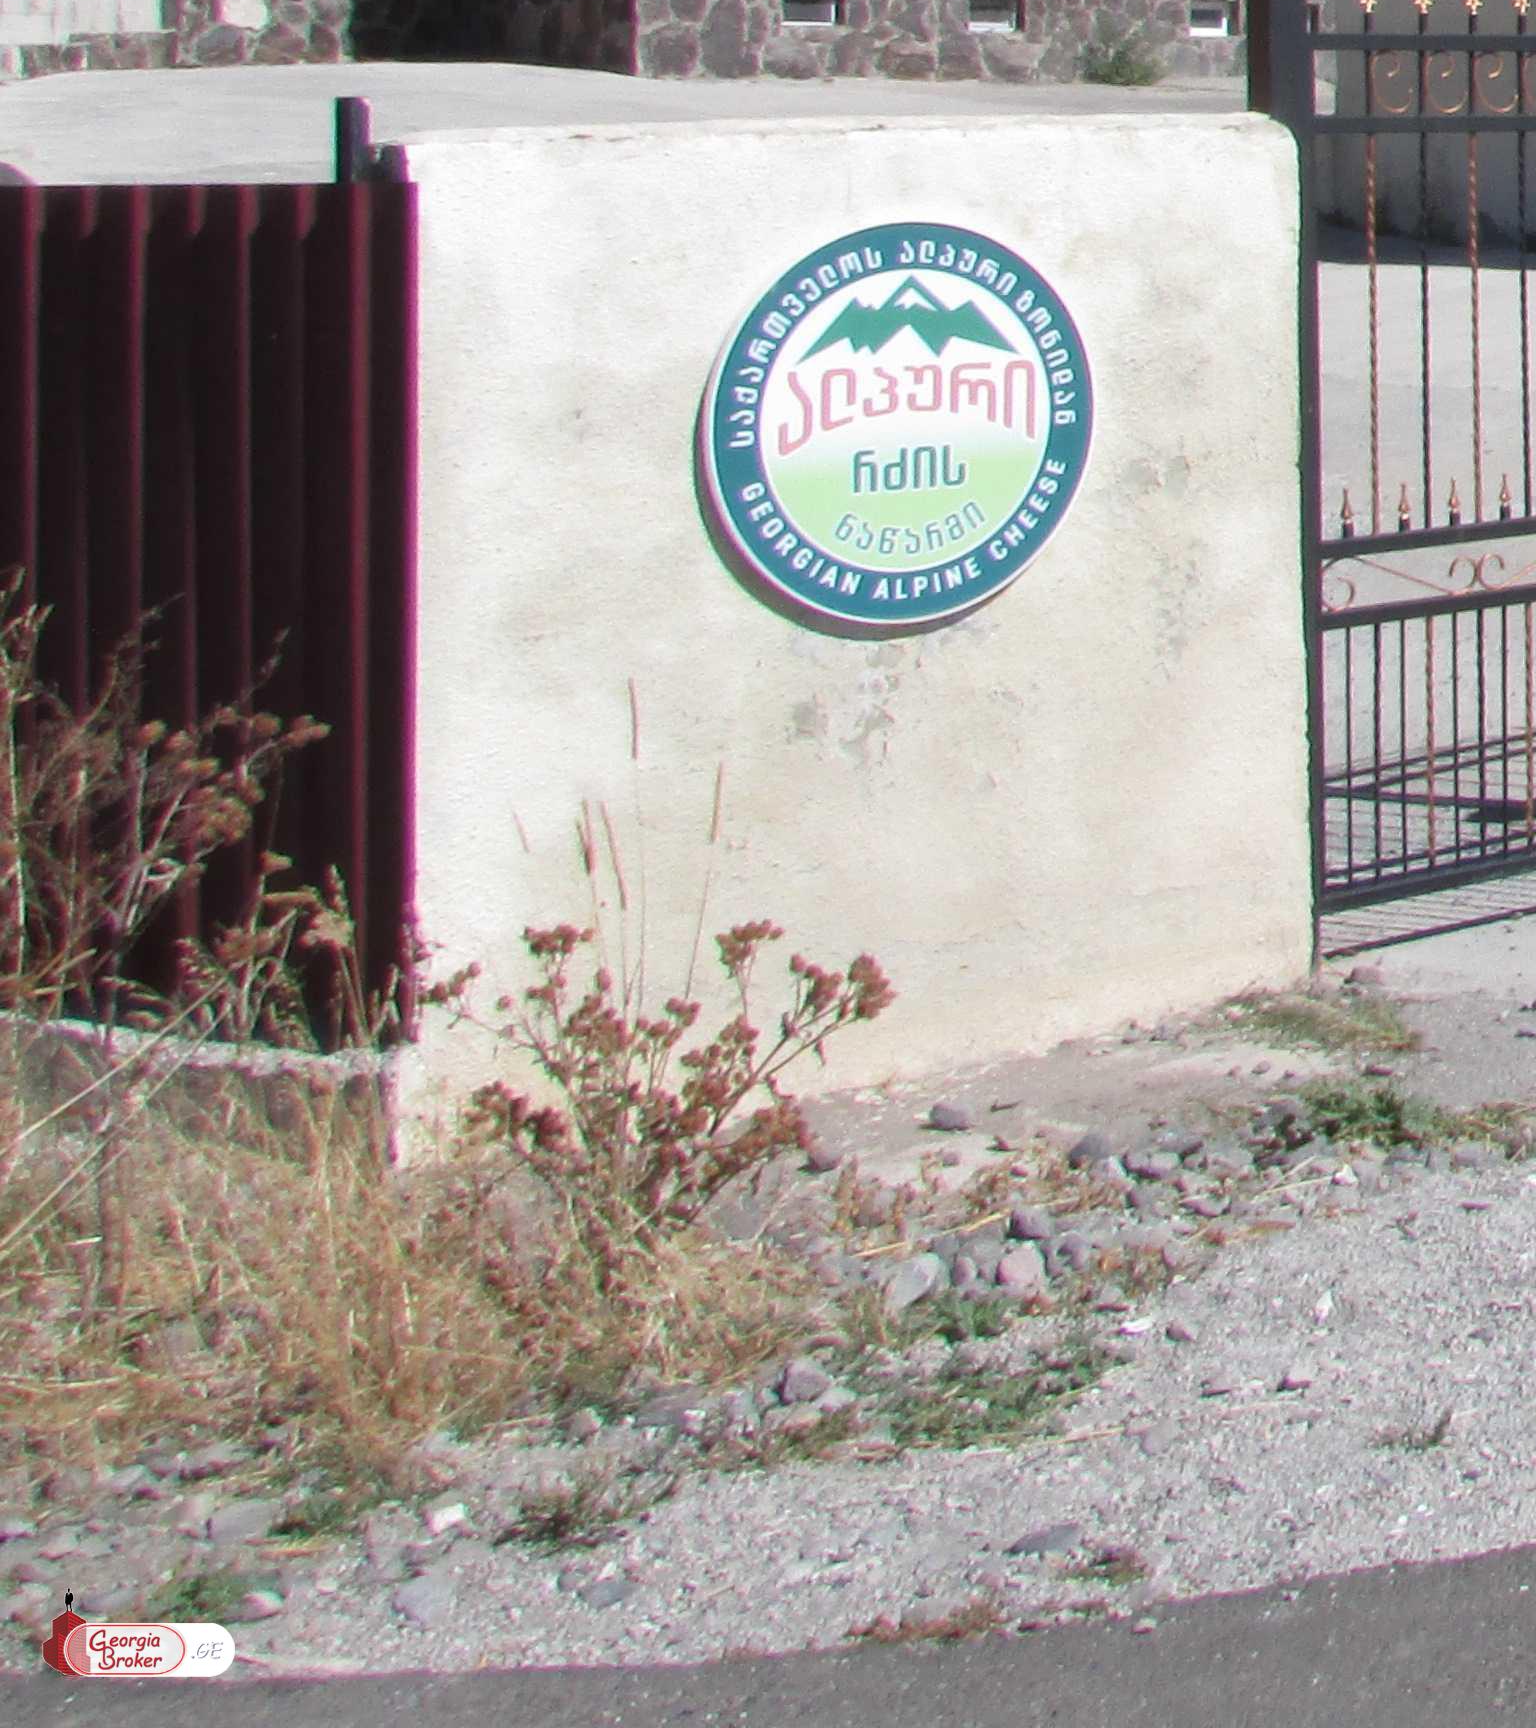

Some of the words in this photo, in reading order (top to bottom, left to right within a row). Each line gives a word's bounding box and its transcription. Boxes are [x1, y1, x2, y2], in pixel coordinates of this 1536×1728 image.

[729, 246, 884, 448] საქართველოს
[900, 240, 1018, 298] ალპური
[1014, 289, 1076, 426] ზონიდან
[777, 359, 1037, 457] ალპური
[853, 444, 967, 494] რძის
[740, 481, 863, 596] GEORGIAN
[872, 555, 983, 601] ALPINE
[989, 458, 1067, 561] CHEESE
[834, 500, 986, 556] ნაწარმი
